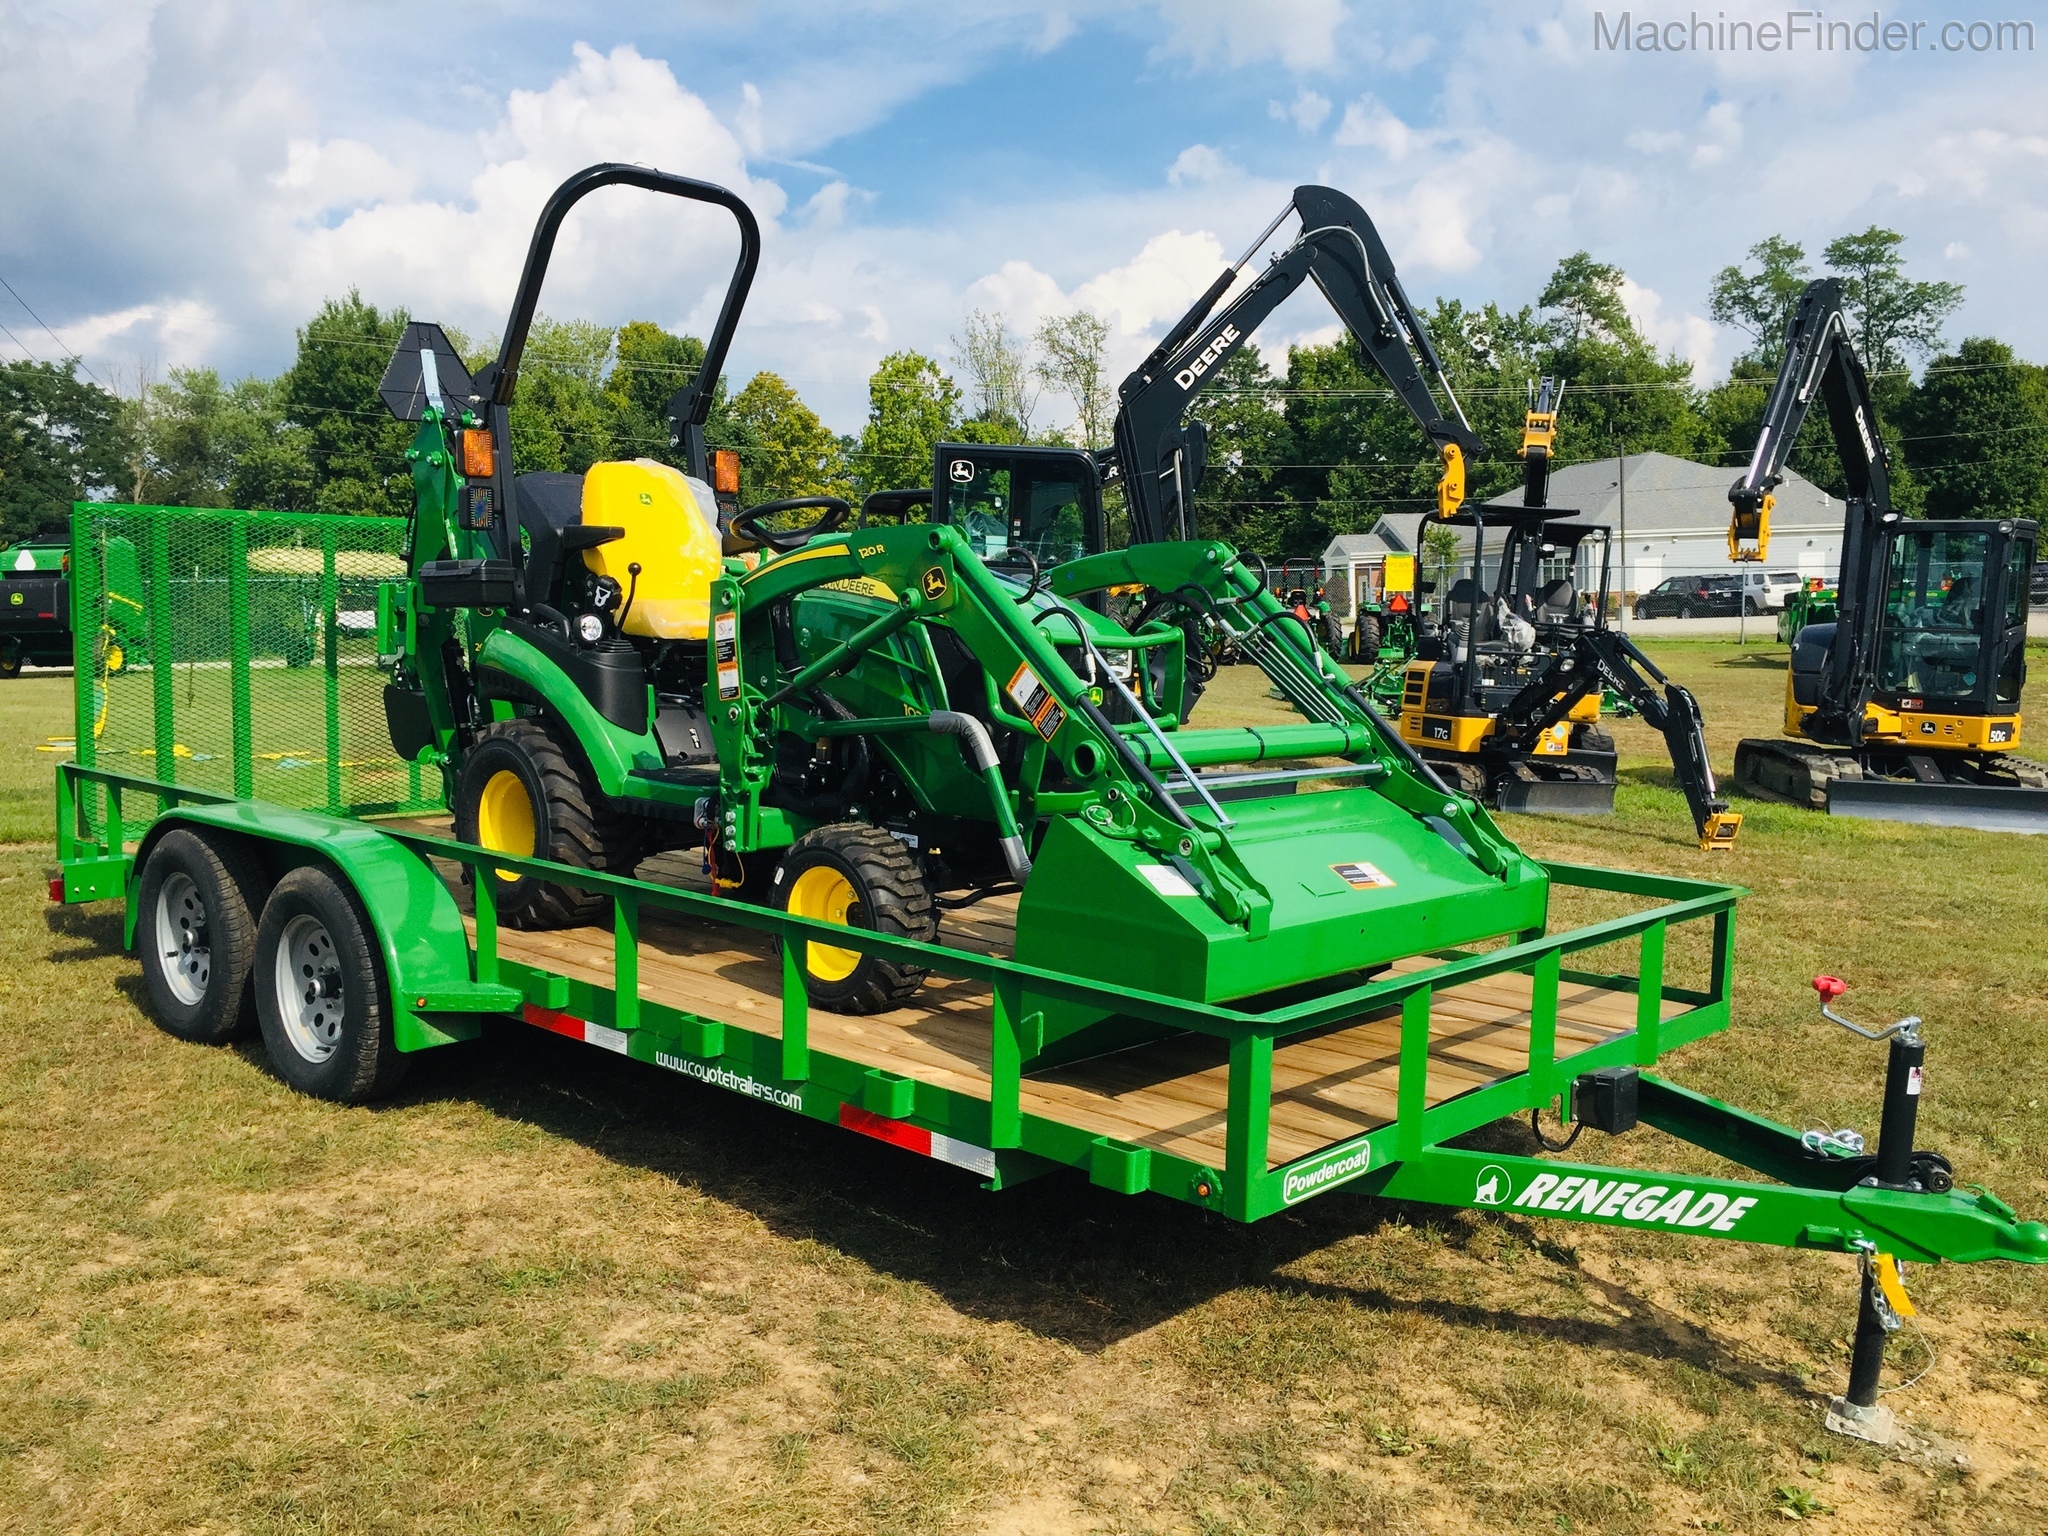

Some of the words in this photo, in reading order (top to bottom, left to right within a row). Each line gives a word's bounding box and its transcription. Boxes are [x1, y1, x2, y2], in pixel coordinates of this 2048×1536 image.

[1173, 323, 1241, 391] DEERE
[1855, 405, 1876, 464] DEERE
[858, 546, 876, 559] 120
[876, 544, 885, 554] R
[841, 579, 876, 595] DEERE
[1434, 727, 1449, 740] 17G
[1990, 730, 2006, 743] 50G
[655, 1050, 802, 1111] www.coyotetrailers.com
[1286, 1147, 1367, 1196] Powdercoat
[1513, 1173, 1759, 1232] RENEGADE
